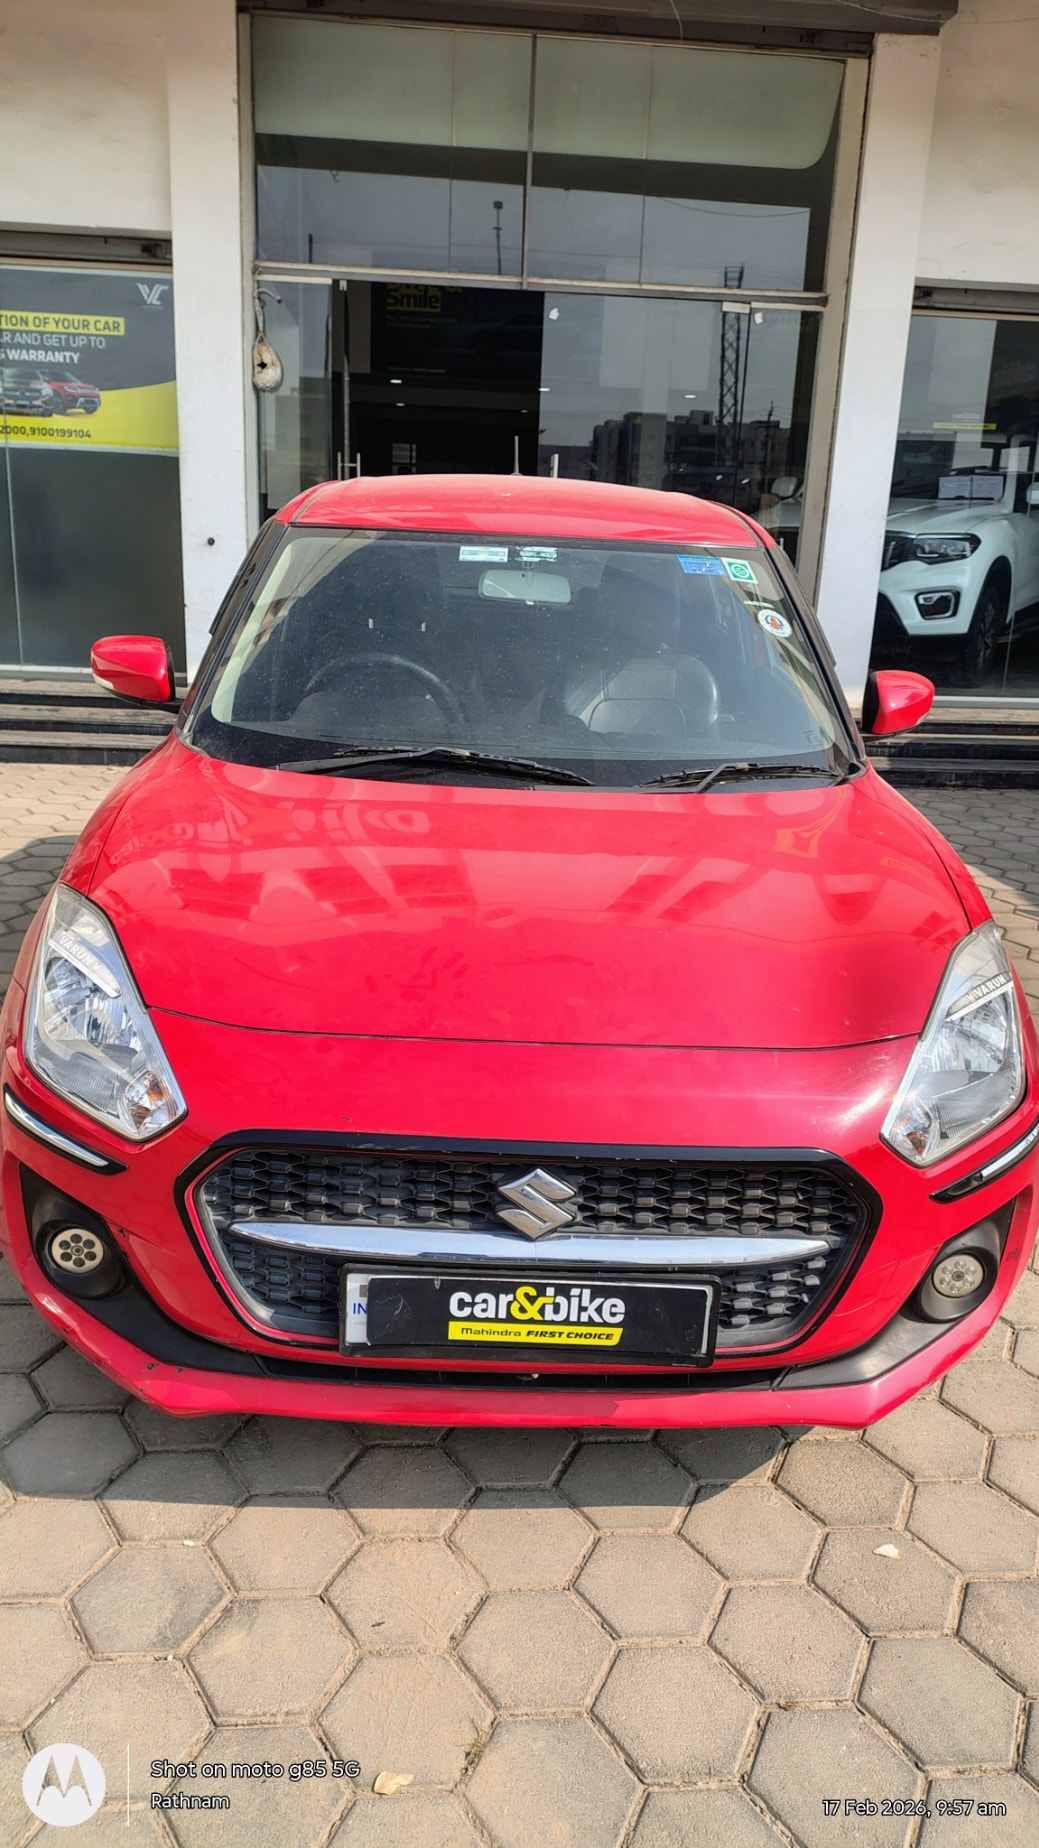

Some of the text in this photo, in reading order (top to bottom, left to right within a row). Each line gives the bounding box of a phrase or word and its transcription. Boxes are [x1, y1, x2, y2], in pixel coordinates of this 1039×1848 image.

[386, 285, 441, 309] Smile
[32, 316, 50, 328] OF
[52, 317, 90, 330] YOUR
[94, 319, 121, 333] CAR
[13, 332, 41, 345] AND
[43, 334, 67, 347] GET
[69, 335, 87, 348] UP
[88, 336, 106, 349] TO
[6, 348, 80, 364] WARRANTY
[59, 934, 93, 966] VARUN
[974, 975, 1006, 998] VARUN
[353, 1302, 368, 1315] IN
[449, 1285, 626, 1324] car&bike
[461, 1327, 614, 1341] Mahindra FIRST CHOICE
